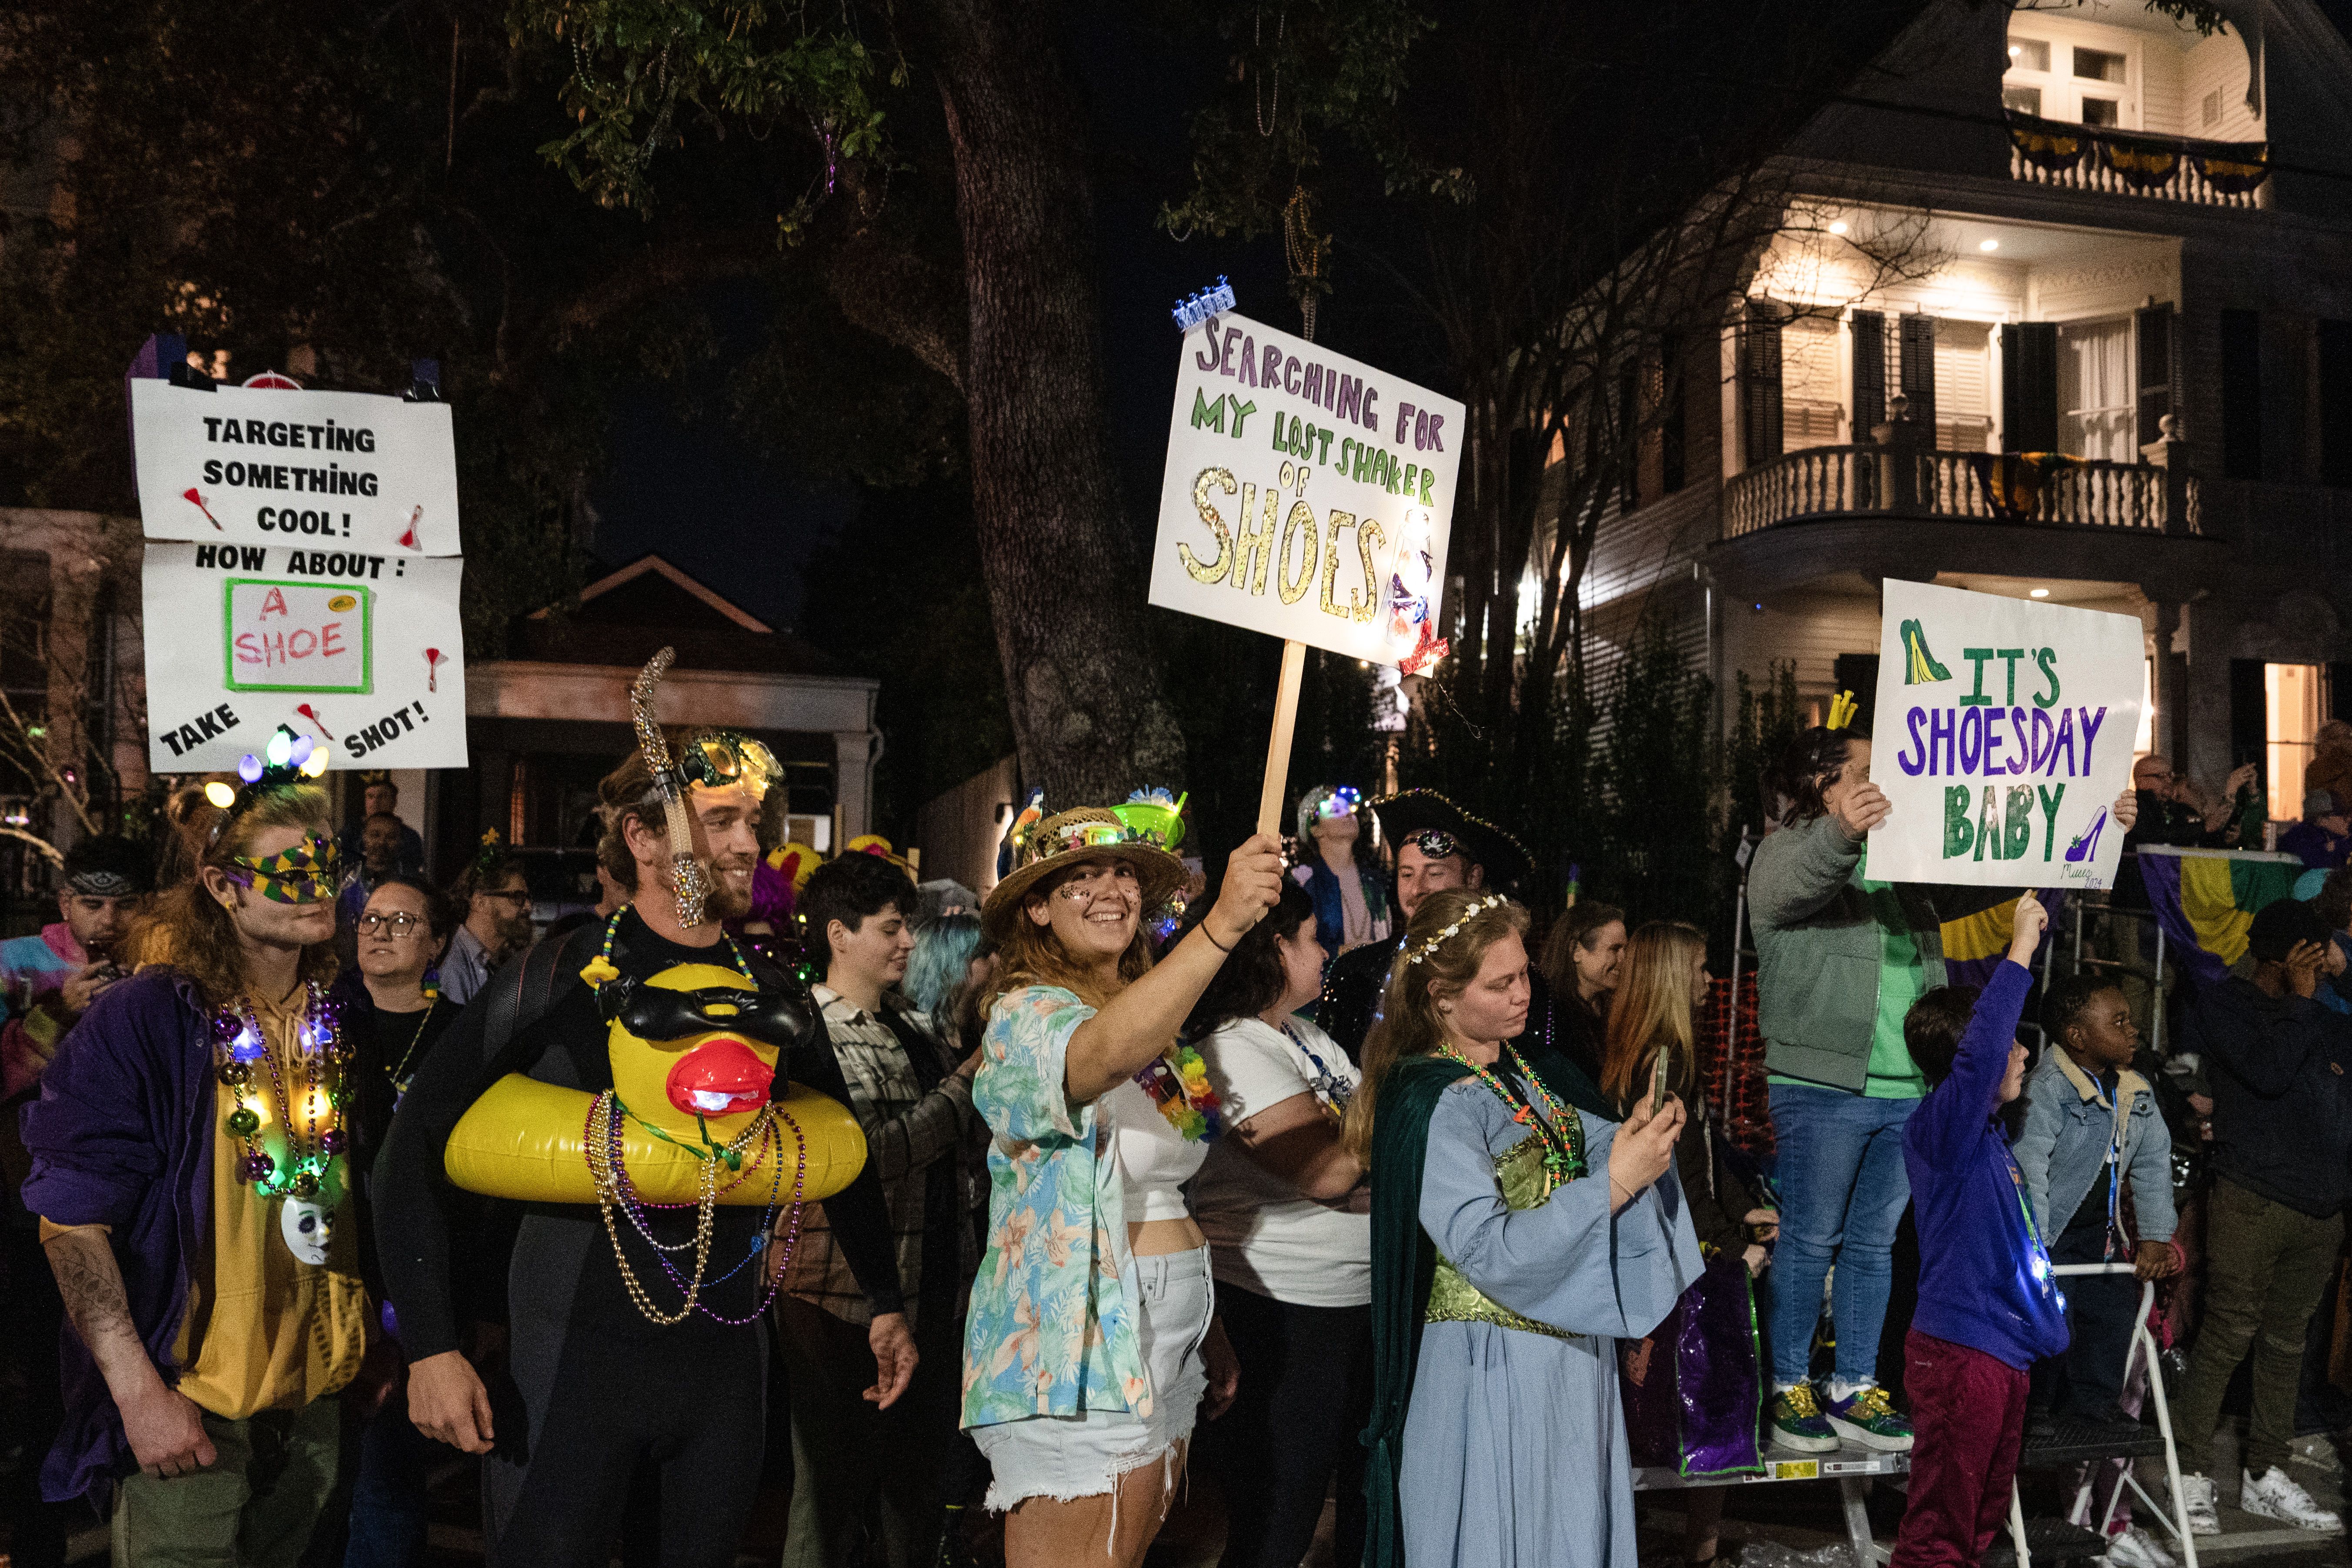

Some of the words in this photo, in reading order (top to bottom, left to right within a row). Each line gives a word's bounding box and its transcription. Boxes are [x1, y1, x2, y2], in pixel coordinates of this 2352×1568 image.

[1196, 317, 1378, 431] SEARCHING
[1396, 402, 1444, 452] FOR
[1191, 387, 1257, 438] MY
[1273, 411, 1334, 465] LOST
[1335, 437, 1434, 507] SHAKER
[1279, 461, 1310, 497] OF
[257, 507, 351, 537] COOL!
[1176, 465, 1386, 625] SHOES
[196, 545, 266, 571] HOW
[260, 587, 287, 620] A
[235, 622, 346, 667] SHOE
[1959, 647, 2060, 709] IT'S
[160, 703, 240, 756] TAKE
[344, 700, 429, 758] SHOT!
[1898, 705, 2107, 776] SHOESDAY
[1943, 783, 2066, 862] BABY
[2084, 878, 2102, 889] 2024
